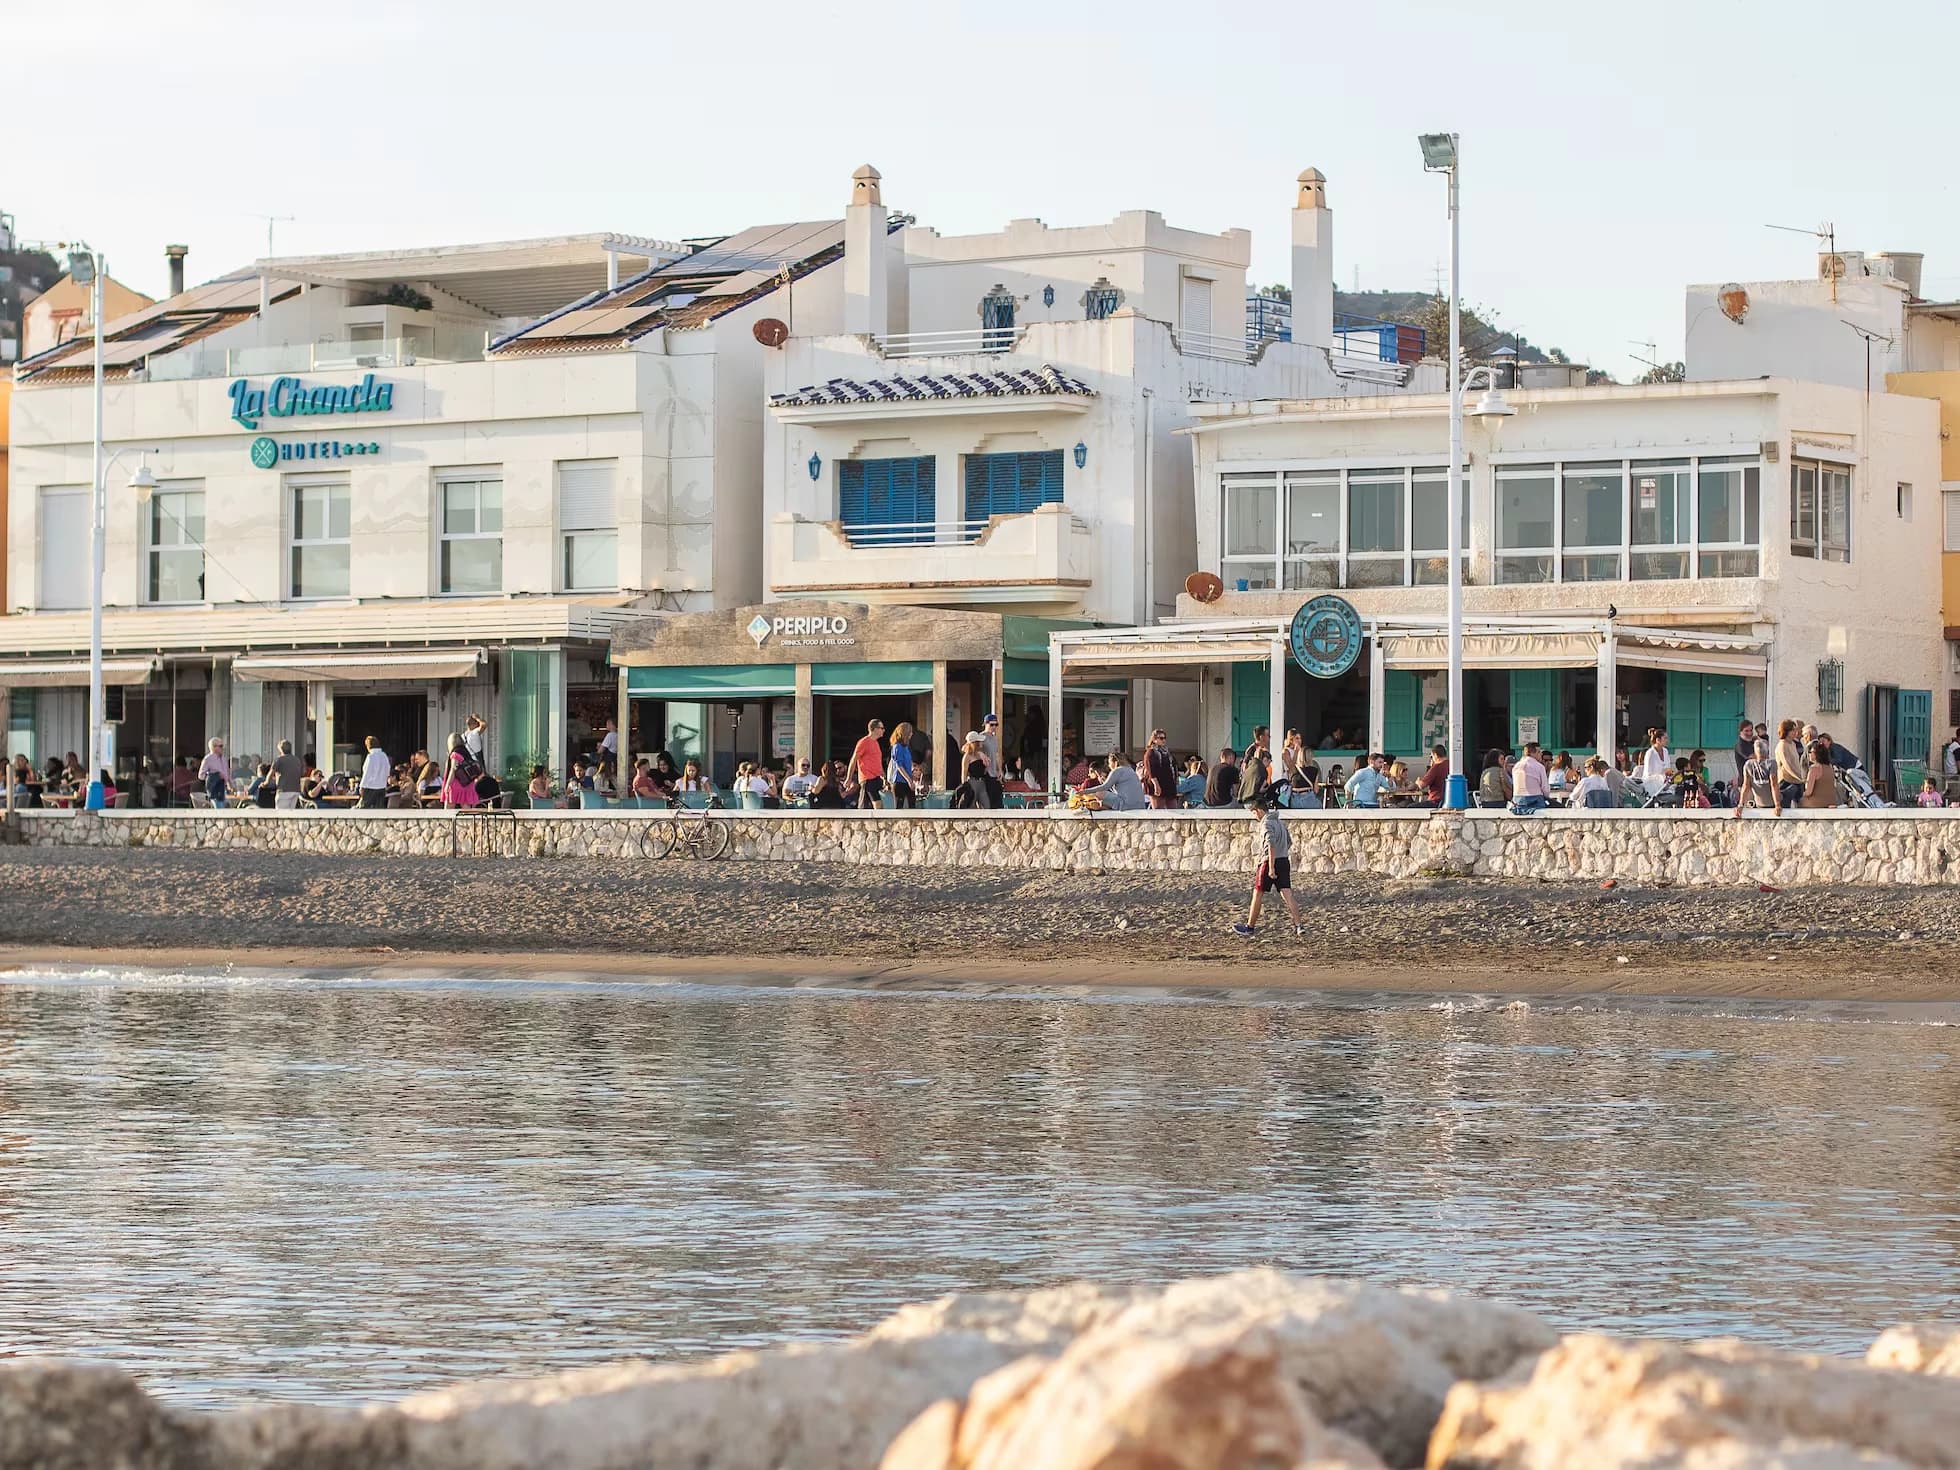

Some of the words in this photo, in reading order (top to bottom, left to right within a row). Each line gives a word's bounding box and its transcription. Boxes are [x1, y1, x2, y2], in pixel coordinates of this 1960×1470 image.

[228, 379, 264, 430] La
[268, 374, 394, 417] Chancla
[281, 441, 342, 461] HOTEL
[773, 616, 848, 635] PERIPLO
